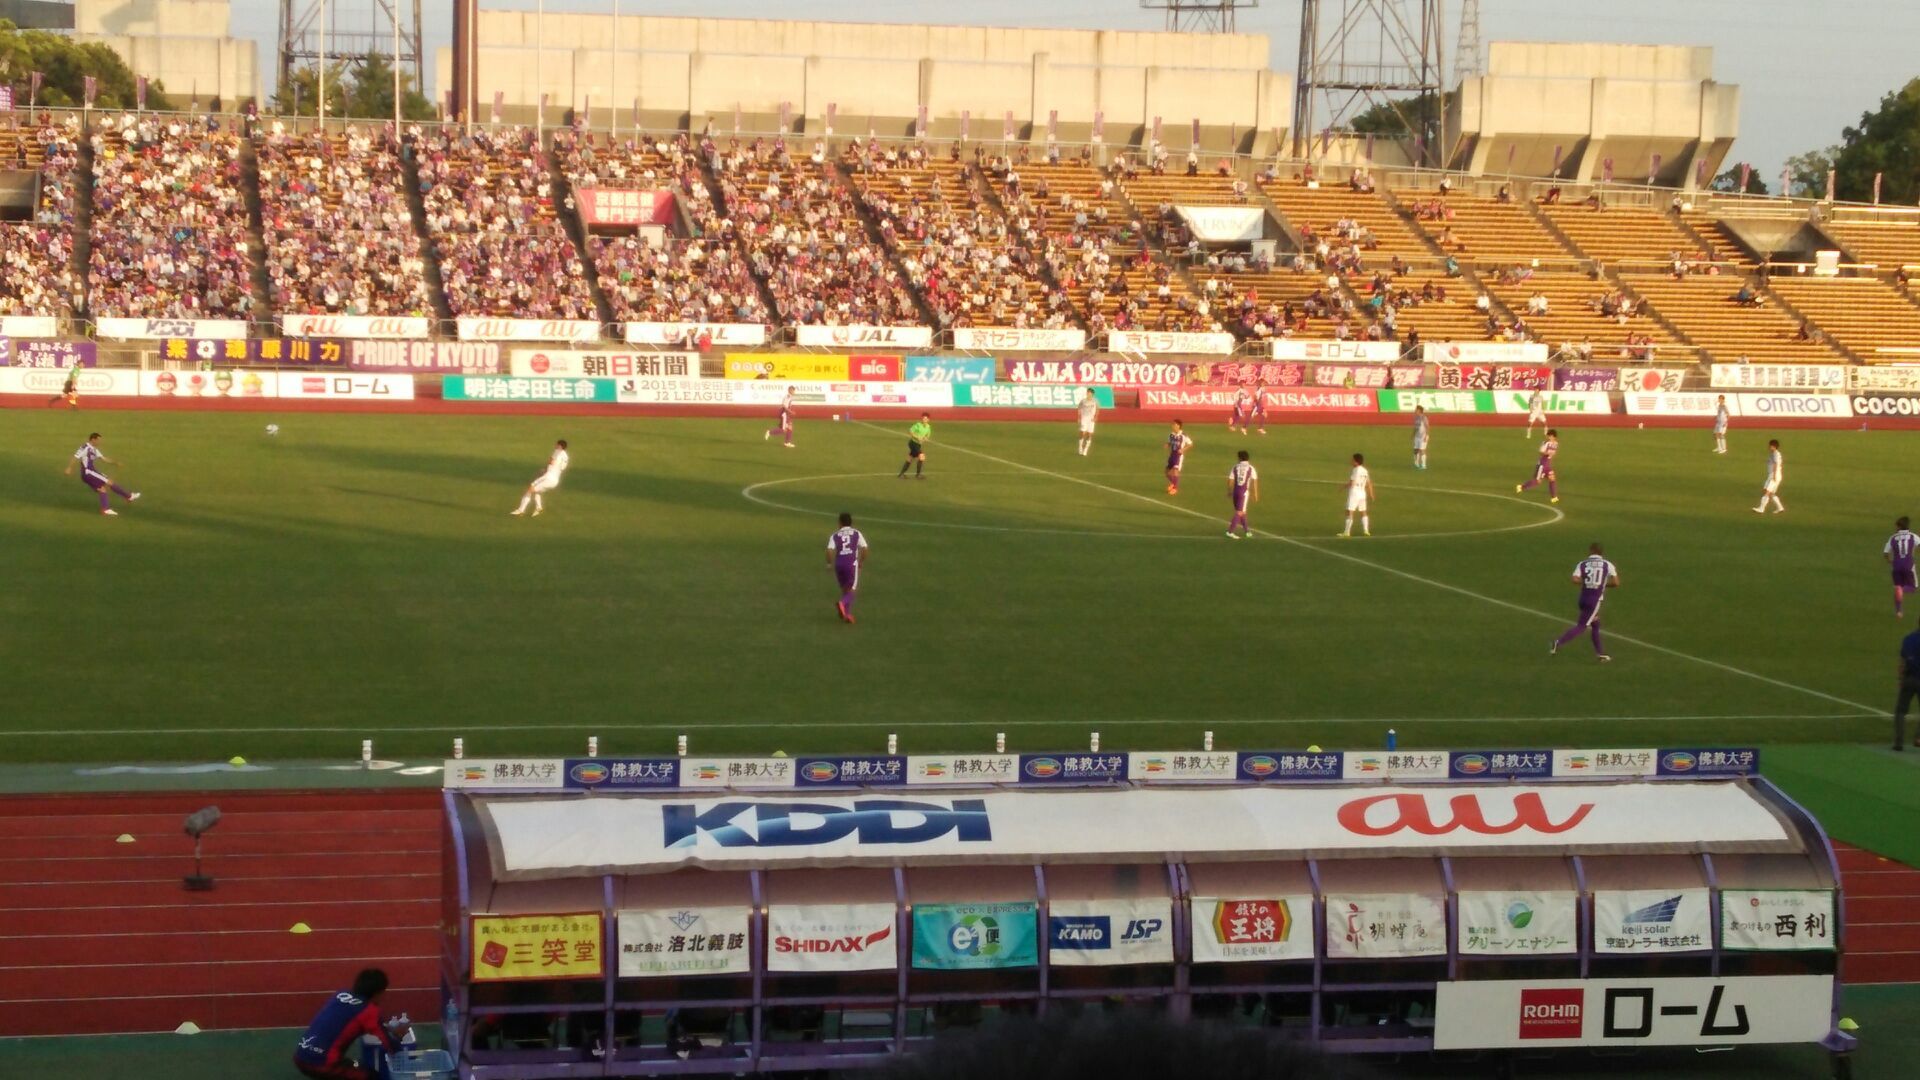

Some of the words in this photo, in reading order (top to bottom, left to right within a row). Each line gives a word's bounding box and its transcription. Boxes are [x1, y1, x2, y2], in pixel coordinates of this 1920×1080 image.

[368, 318, 407, 336] au
[475, 320, 516, 337] au
[541, 321, 582, 338] au
[854, 329, 897, 342] JAL
[352, 341, 407, 366] PRIDE
[411, 342, 434, 367] OF
[437, 342, 499, 368] KYOTO
[582, 355, 689, 376] 朝日新聞
[1010, 362, 1076, 383] ALMA
[1079, 363, 1106, 383] DE
[1109, 363, 1181, 385] KYOTO
[334, 378, 389, 394] ローム
[464, 377, 596, 399] 明治安田生命
[641, 380, 678, 391] 2015
[654, 391, 671, 401] J2
[673, 391, 733, 402] LEAGUE
[1756, 397, 1836, 414] OMRON
[1584, 567, 1603, 586] 30
[953, 758, 1012, 774] 佛教大学
[1064, 757, 1122, 772] 佛教大学
[1173, 755, 1231, 770] 佛教大学
[1281, 755, 1337, 770] 佛教大学
[1387, 755, 1443, 769] 佛教大学
[1491, 753, 1547, 768] 佛教大学
[1596, 752, 1651, 766] 佛教大学
[1698, 752, 1753, 767] 佛教大学
[493, 763, 557, 778] 佛教大学
[611, 762, 673, 777] 佛教大学
[728, 762, 788, 777] 佛教大学
[841, 760, 901, 776] 佛教大学
[1337, 792, 1595, 836] au
[662, 799, 992, 849] KDDI
[1235, 903, 1269, 916] 餃子の
[1058, 927, 1103, 940] KAMO
[1120, 918, 1162, 940] JSP
[1229, 917, 1276, 942] 王将
[1622, 924, 1642, 936] keiji
[1644, 924, 1671, 934] solar
[1774, 913, 1826, 938] 西利
[623, 942, 663, 954] 株式会社
[668, 932, 745, 953] 洛北義肢
[775, 936, 863, 953] SHIDAX
[1467, 936, 1569, 950] グリーンエナジー
[512, 938, 596, 966] 三笑堂
[1524, 1004, 1579, 1018] ROHM
[1603, 985, 1751, 1038] ローム
